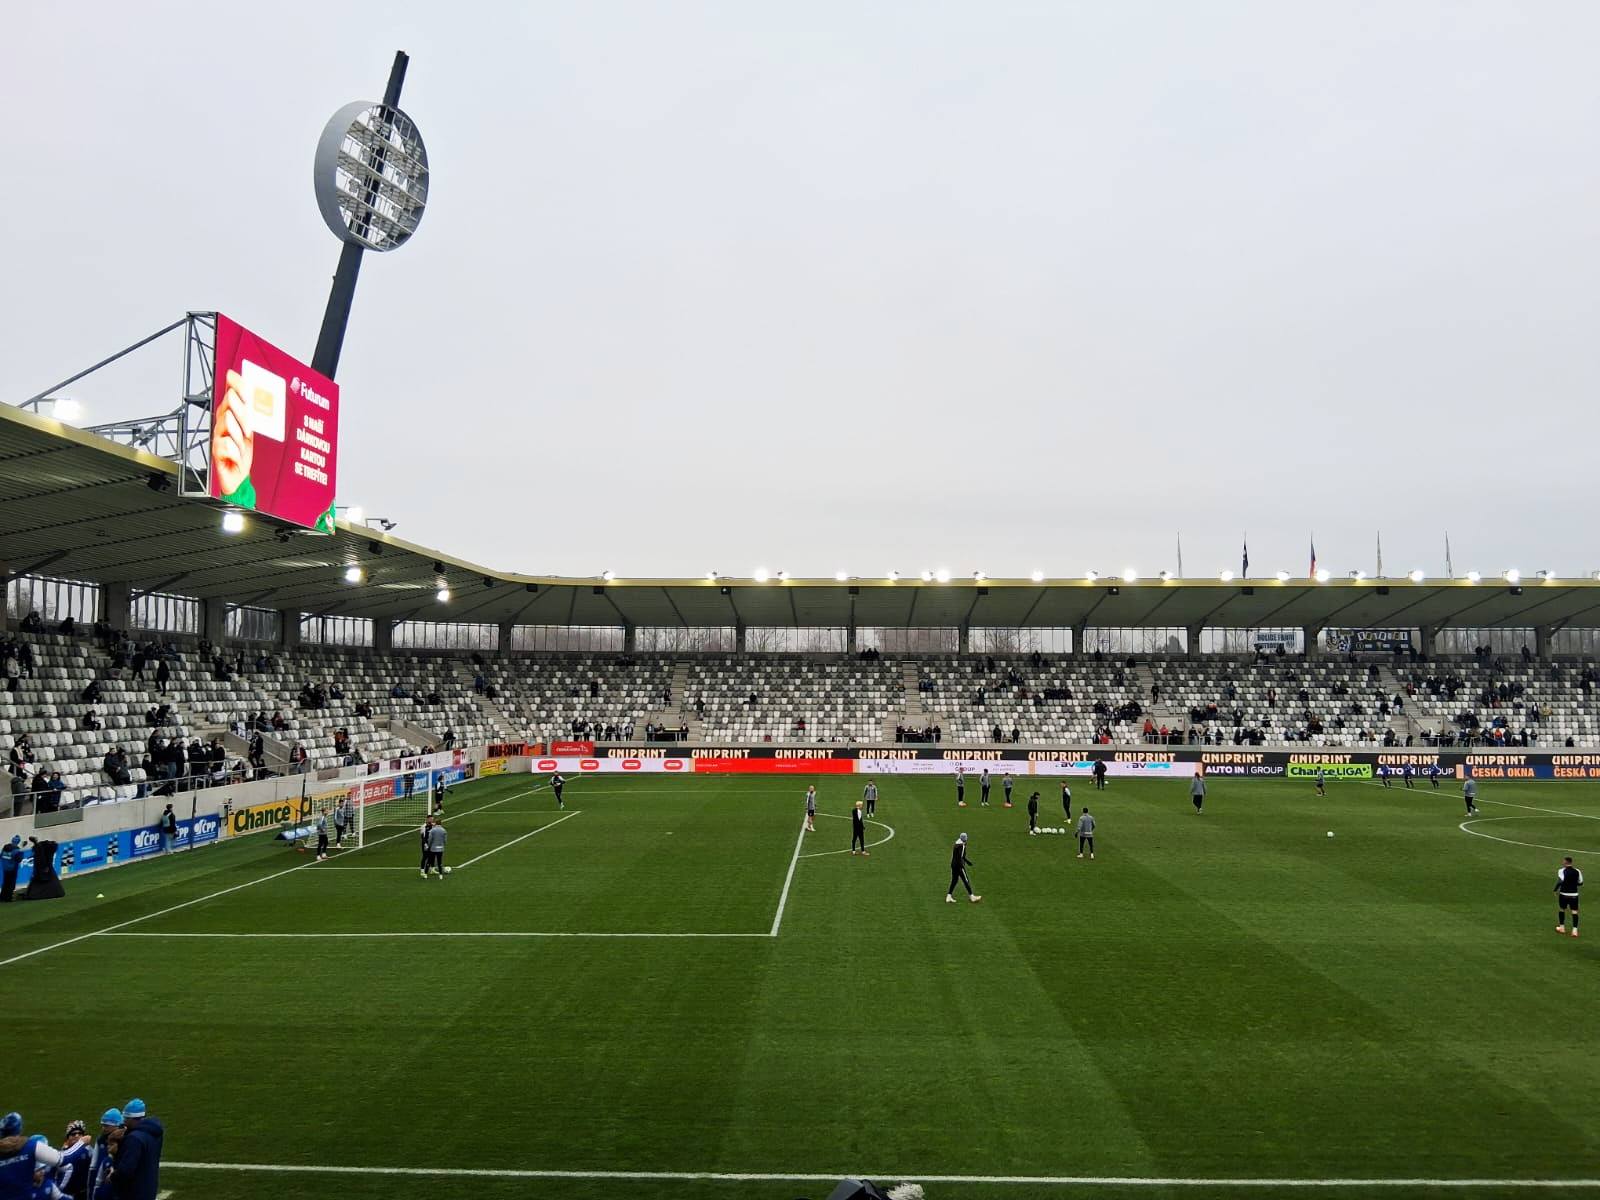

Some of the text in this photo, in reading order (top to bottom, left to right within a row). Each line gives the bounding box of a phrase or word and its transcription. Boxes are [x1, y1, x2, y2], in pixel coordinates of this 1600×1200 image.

[301, 382, 329, 410] Futurum
[608, 749, 666, 758] UNIPRINT
[691, 749, 750, 759] UNIPRINT
[774, 749, 833, 759] UNIPRINT
[858, 750, 918, 759] UNIPRINT
[943, 750, 1003, 760] UNIPRINT
[1028, 751, 1088, 761] UNIPRINT
[1114, 752, 1176, 762] UNIPRINT
[1201, 753, 1264, 763] UNIPRINT
[1290, 754, 1352, 764] UNIPRINT
[1377, 755, 1439, 765] UNIPRINT
[1466, 756, 1527, 765] UNIPRINT
[1205, 766, 1283, 774] AUTO IN GROUP
[1472, 765, 1535, 777] ČESKÁ OKNA
[1554, 765, 1587, 777] ČESKÁ
[234, 805, 291, 832] Chance
[202, 820, 216, 834] ČPP
[144, 832, 160, 846] ČPP
